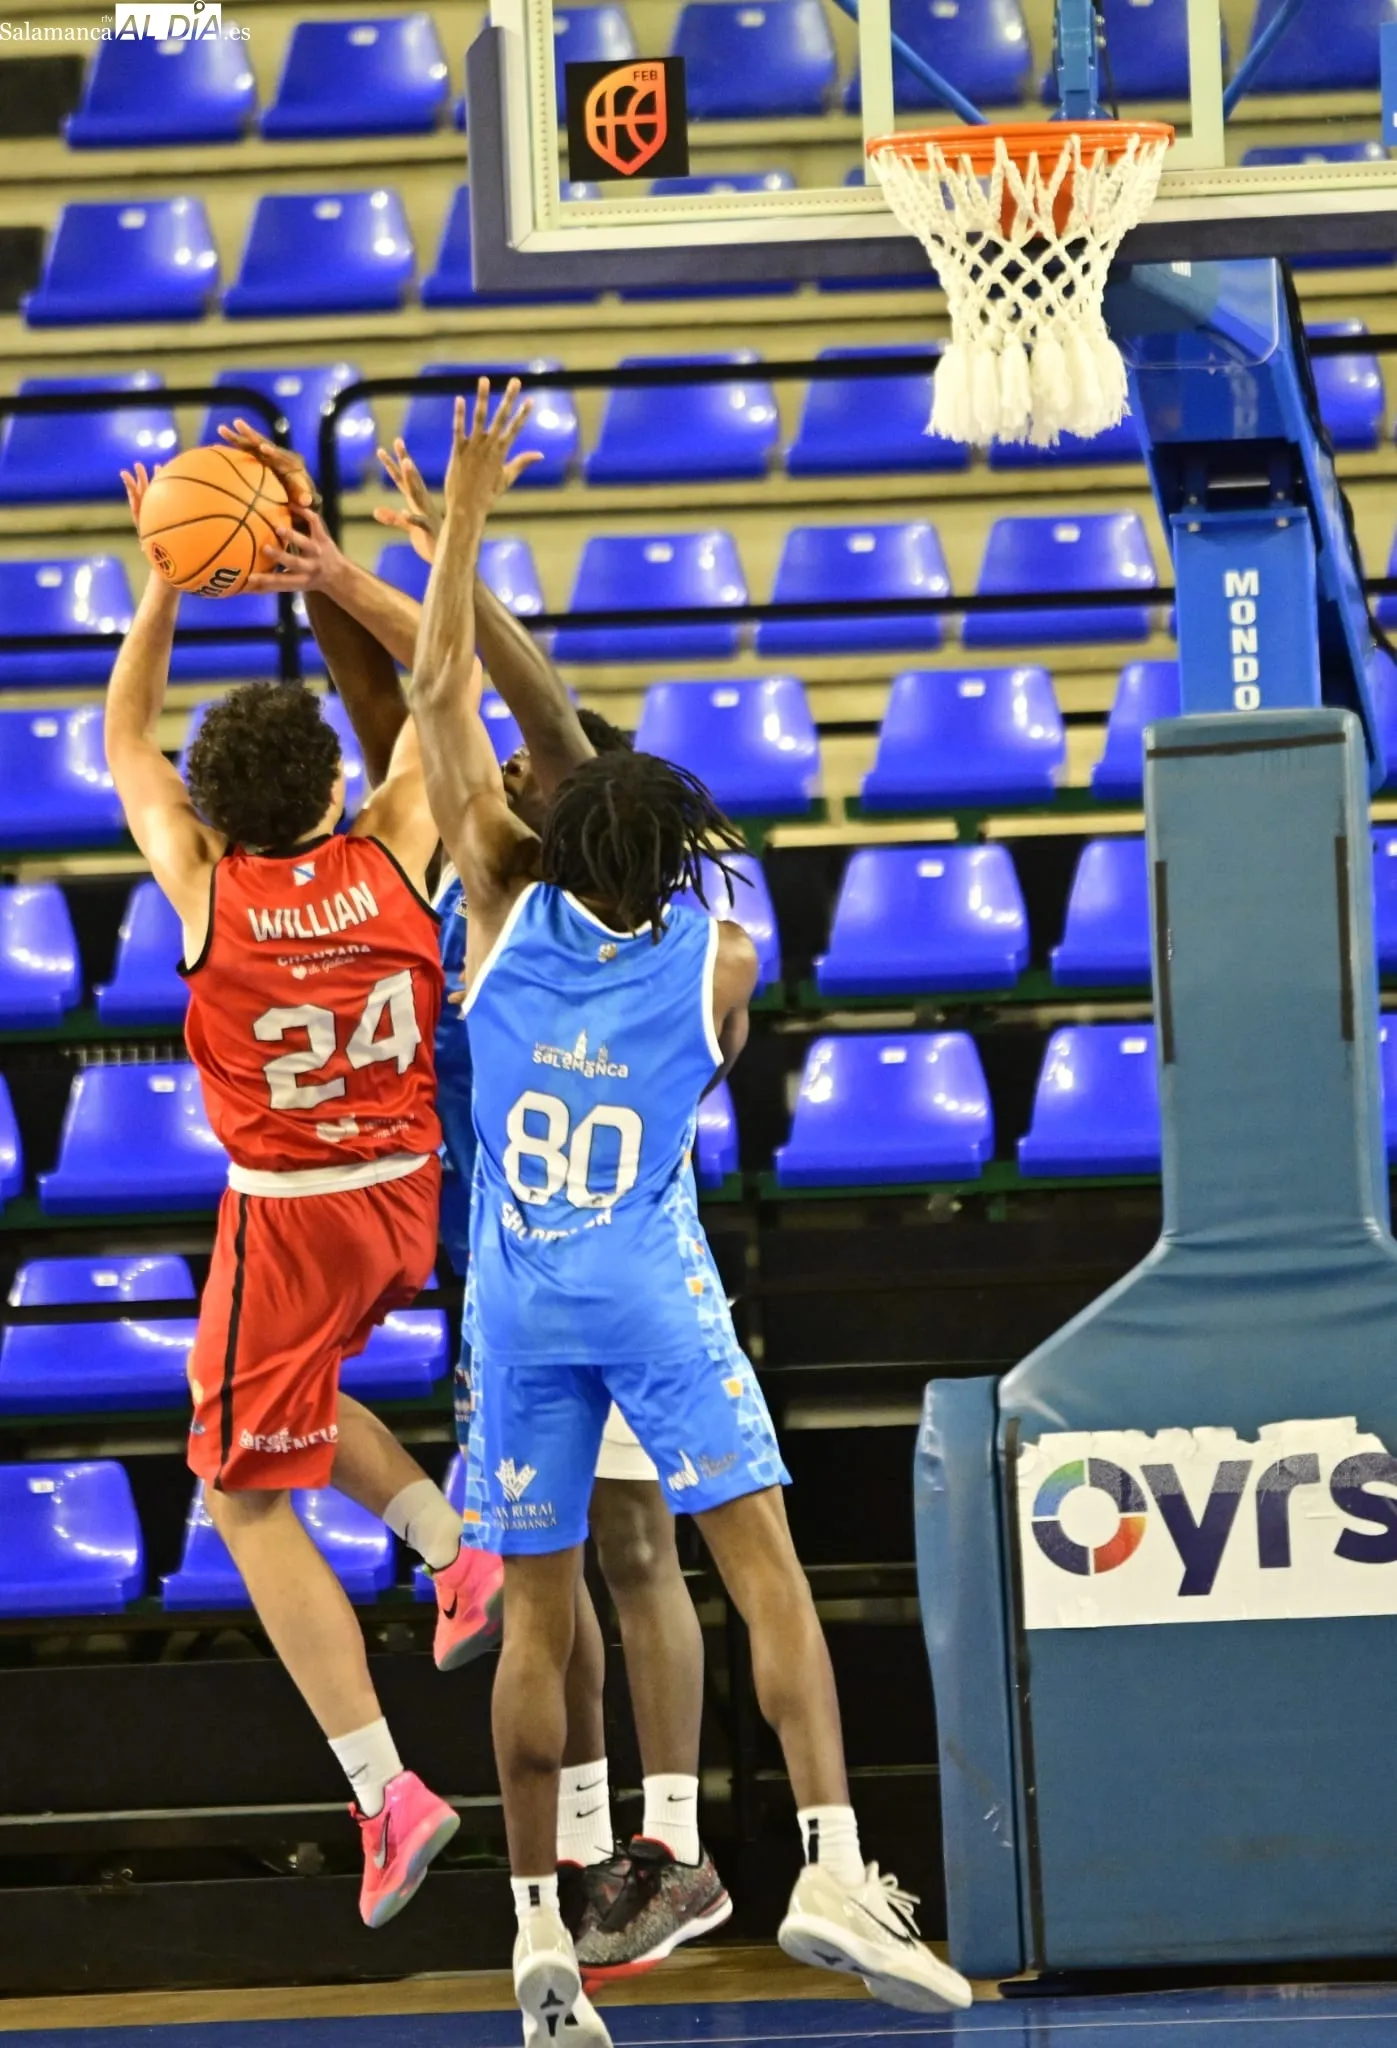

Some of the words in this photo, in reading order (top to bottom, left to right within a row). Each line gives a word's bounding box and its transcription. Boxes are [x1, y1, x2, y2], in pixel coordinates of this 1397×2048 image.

[633, 70, 658, 81] FEB
[1224, 569, 1261, 711] MONDO
[247, 880, 380, 942] WILLIAN
[253, 968, 421, 1110] 24
[503, 1090, 643, 1208] 80
